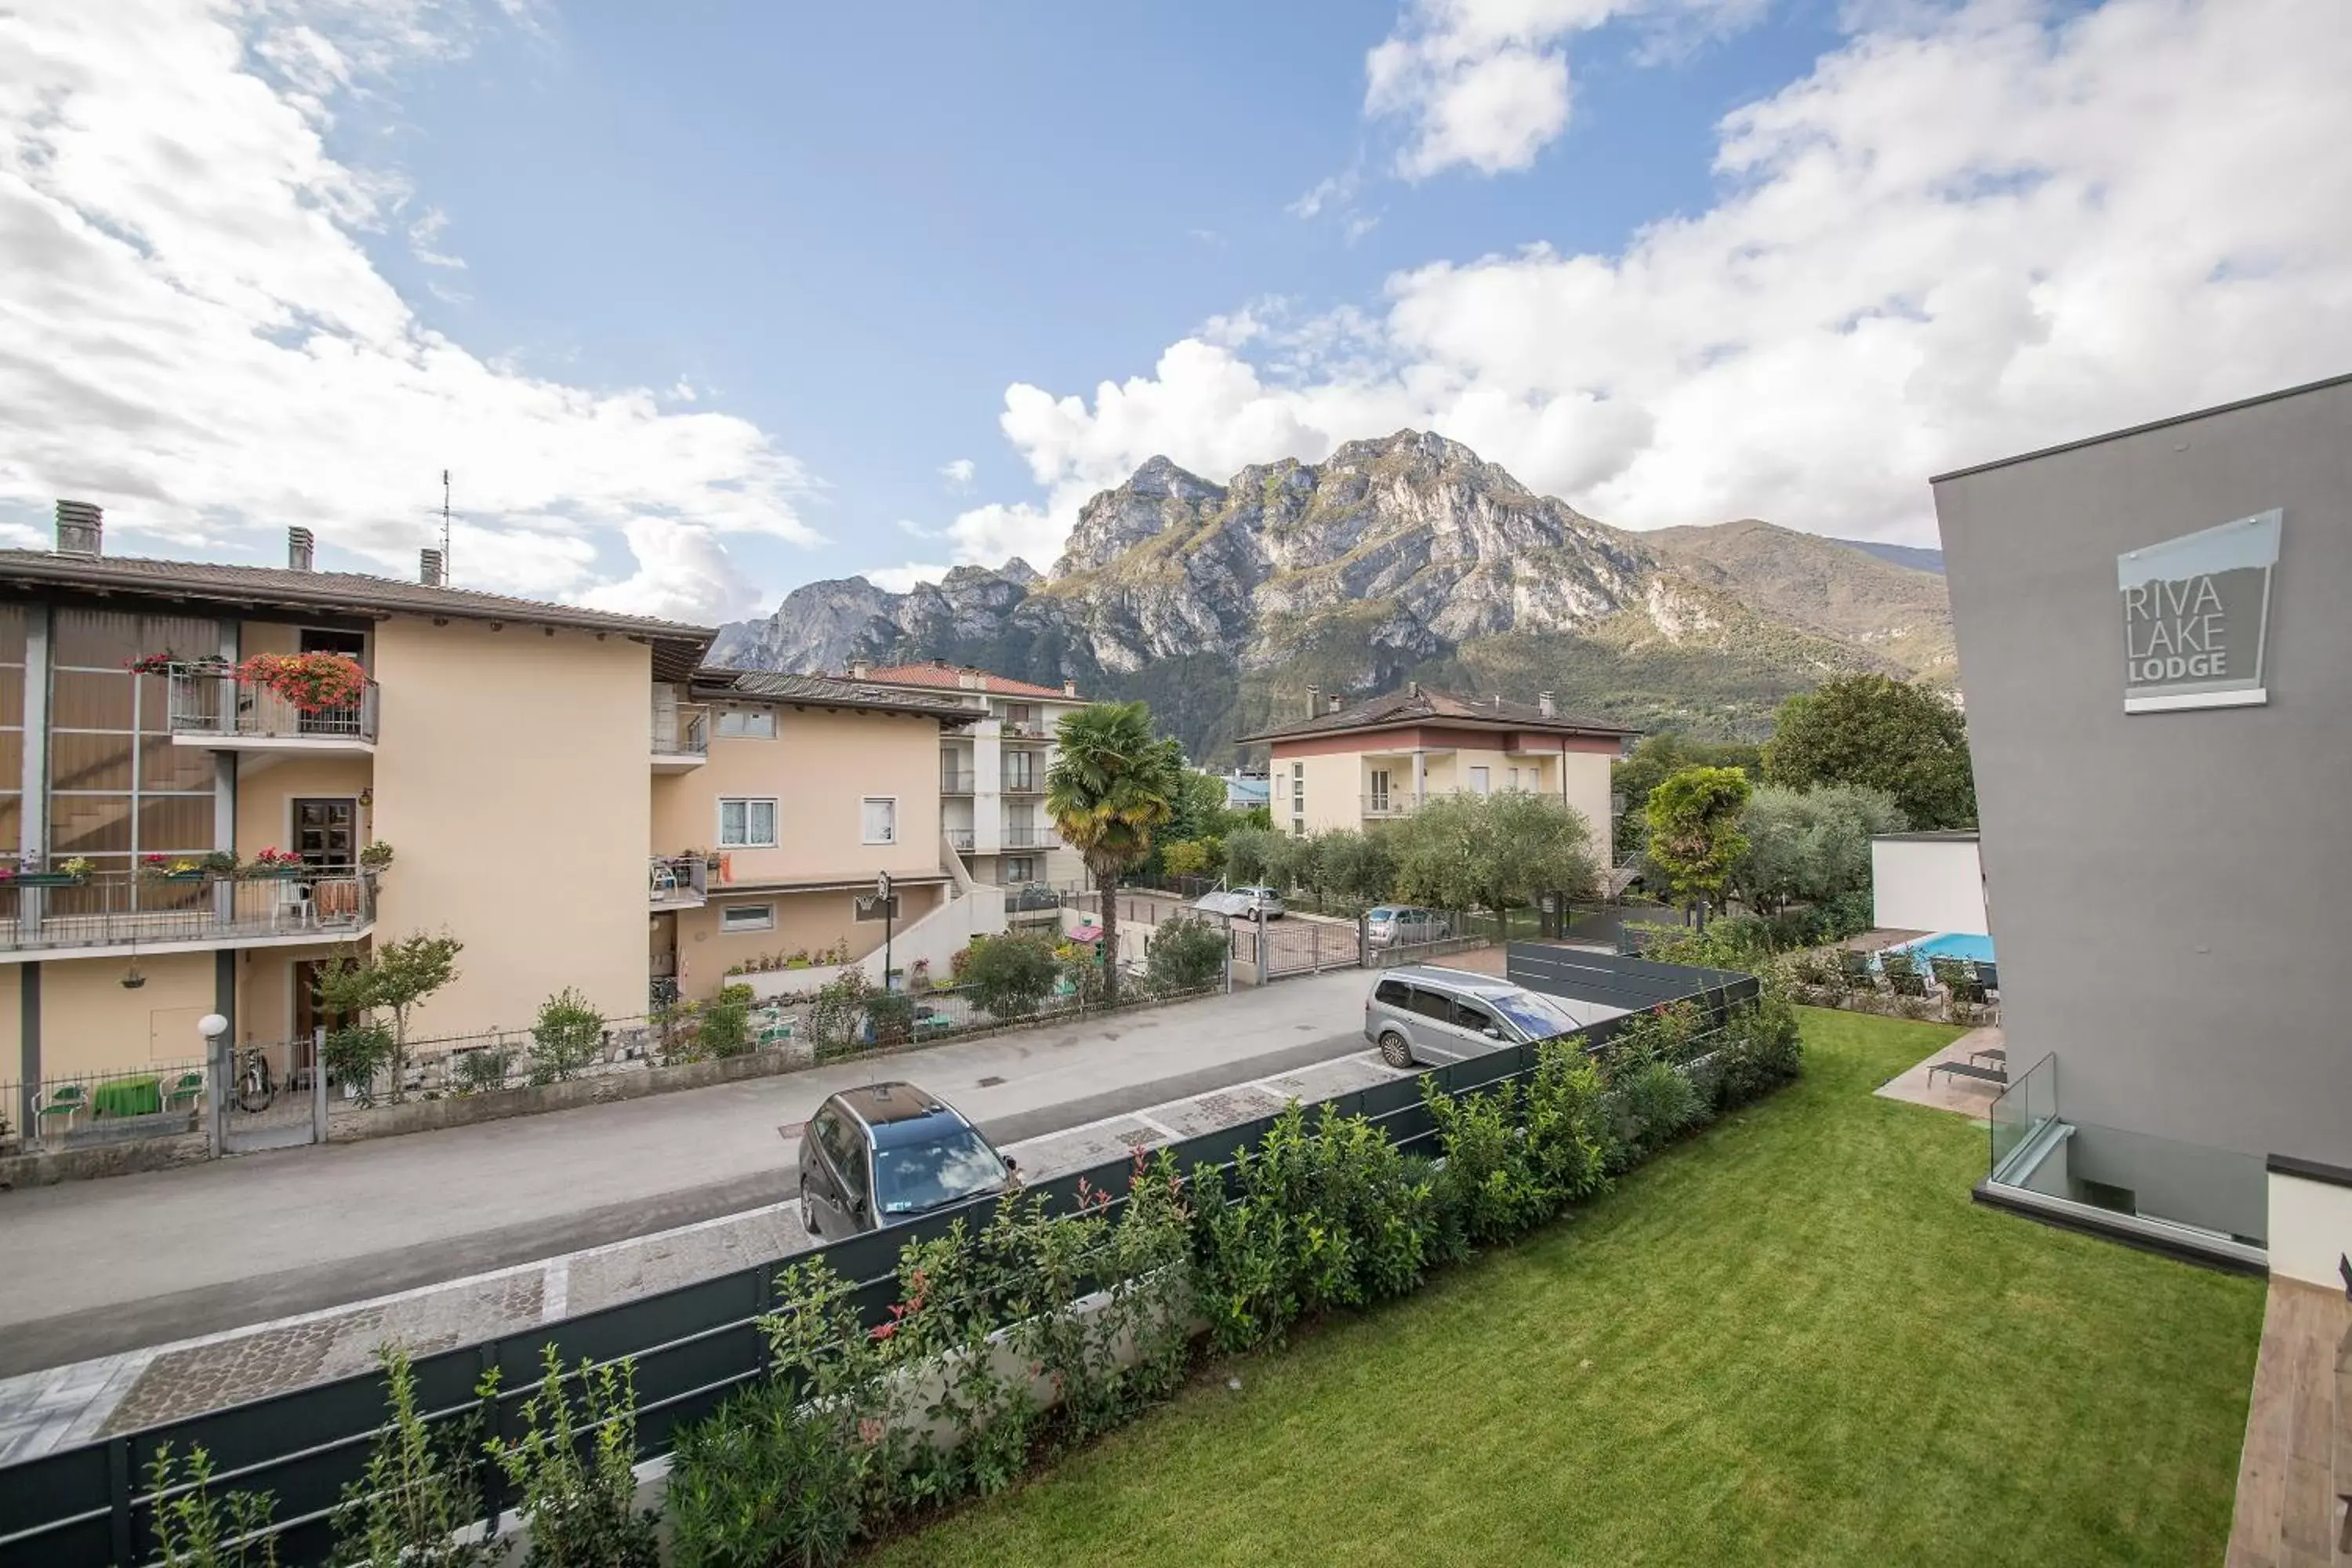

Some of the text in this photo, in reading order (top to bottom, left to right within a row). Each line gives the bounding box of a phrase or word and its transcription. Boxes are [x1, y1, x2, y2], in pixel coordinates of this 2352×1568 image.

[2125, 576, 2223, 620] RIVA
[2127, 613, 2225, 658] LAKE
[2129, 652, 2226, 682] LODGE
